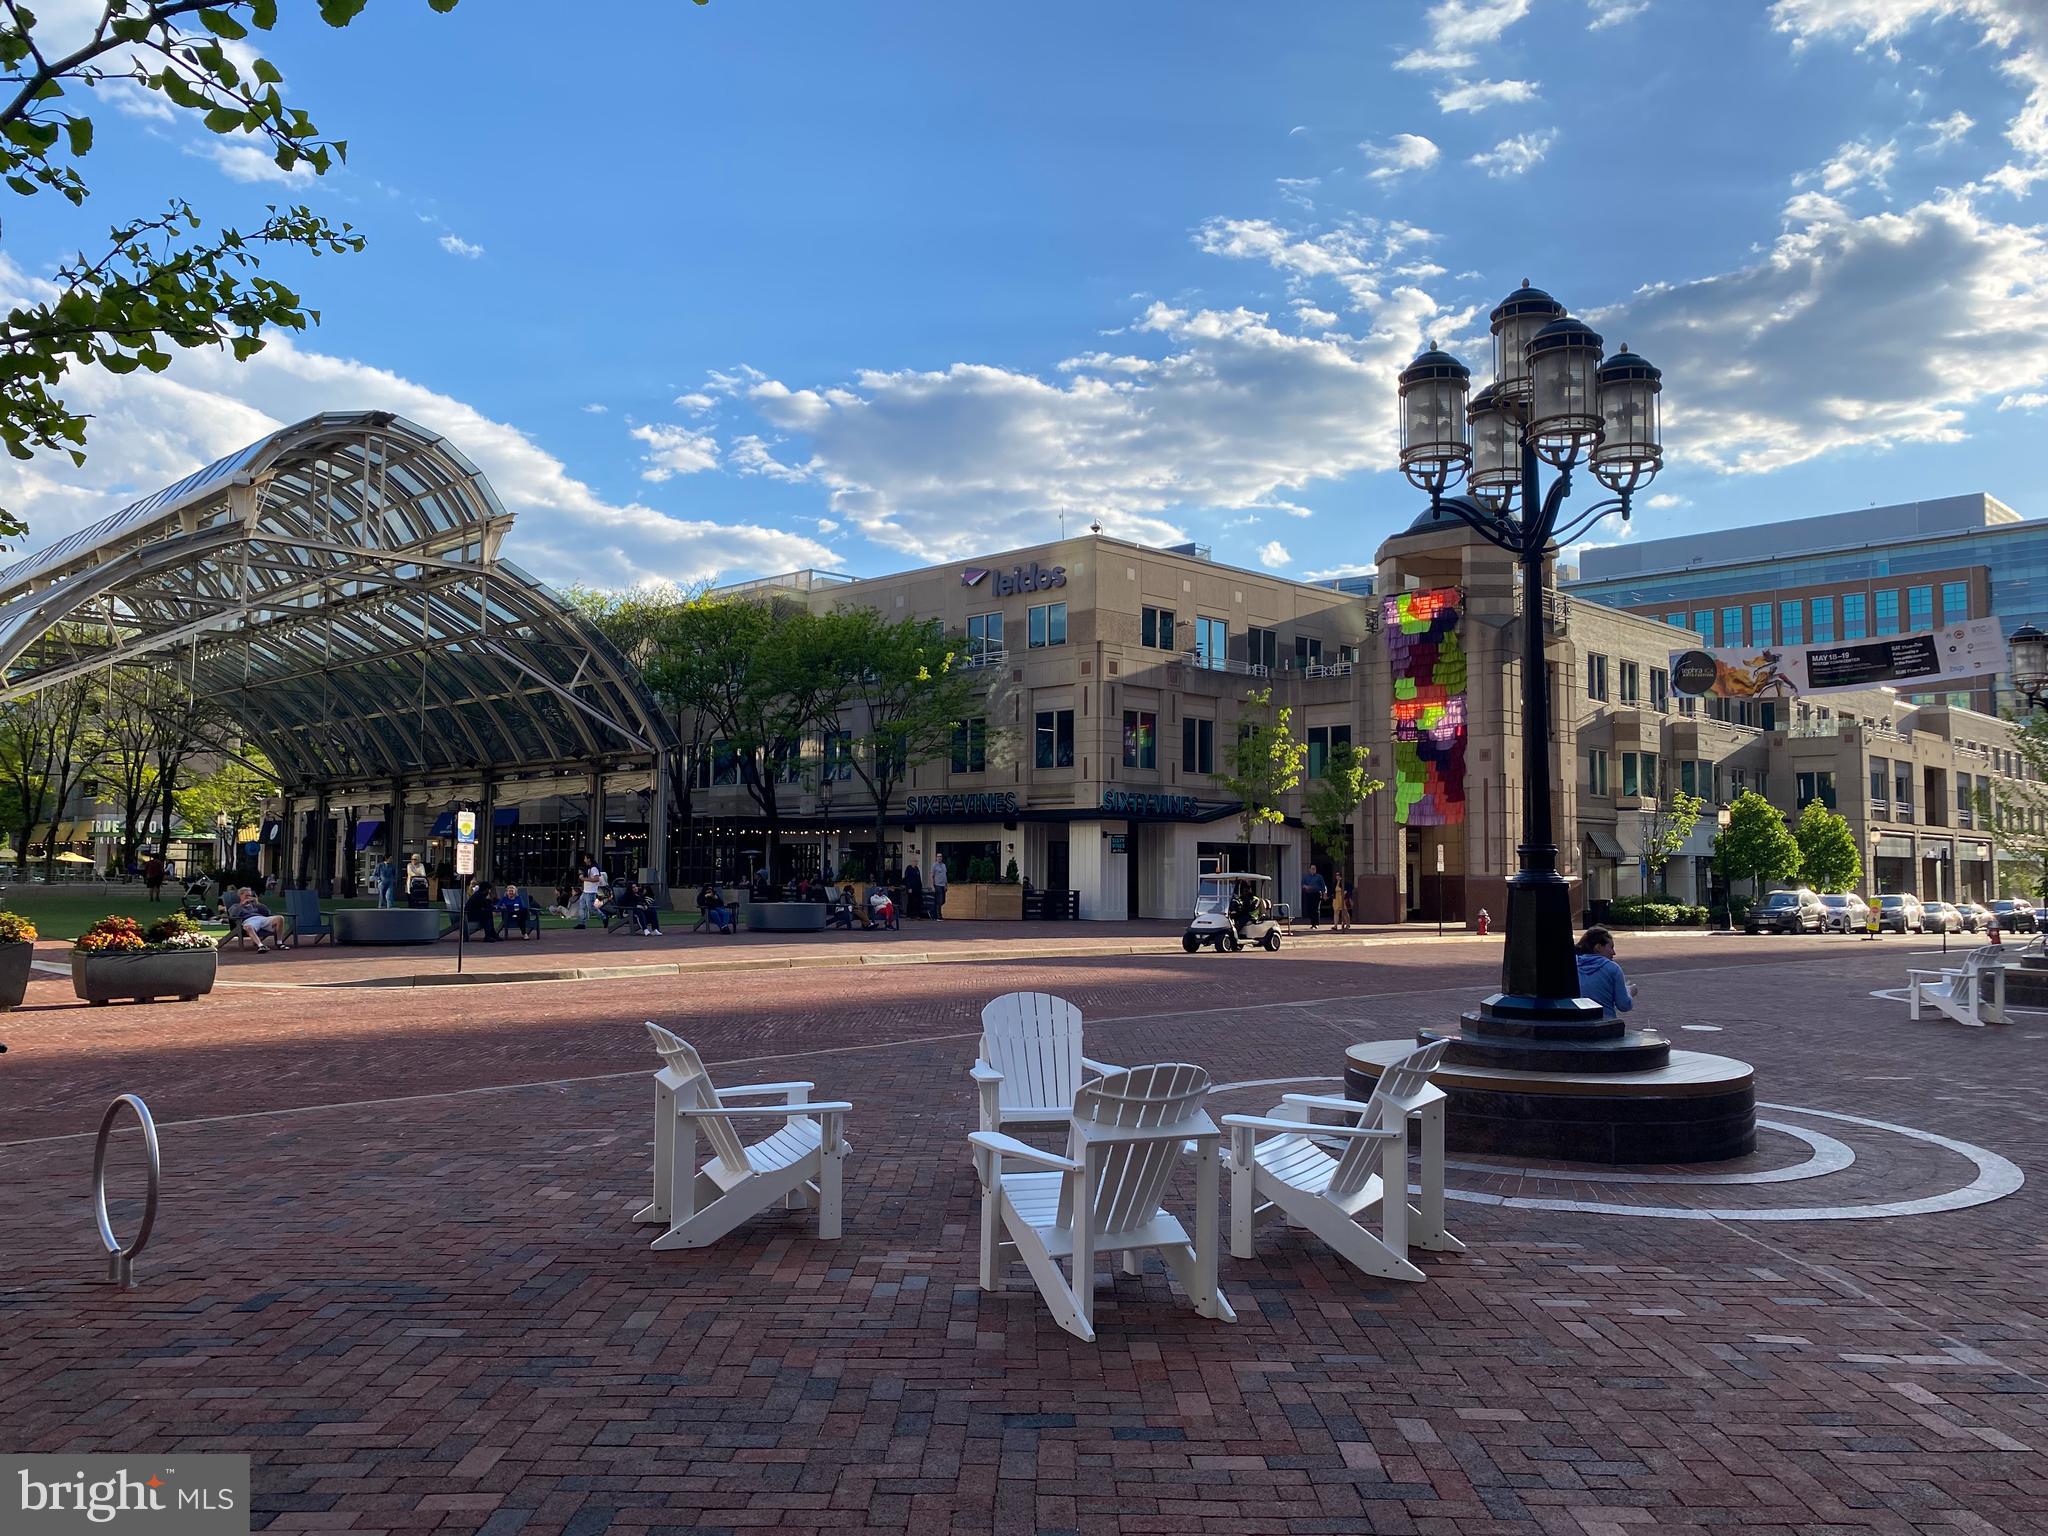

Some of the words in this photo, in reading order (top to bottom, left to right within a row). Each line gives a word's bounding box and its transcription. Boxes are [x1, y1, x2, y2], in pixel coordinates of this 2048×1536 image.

[992, 562, 1067, 597] leidos
[906, 793, 958, 816] SIXTY
[961, 791, 1017, 814] VINES
[1104, 791, 1150, 816] SIXTY
[1151, 795, 1199, 817] VINES
[91, 820, 120, 833] TRUE
